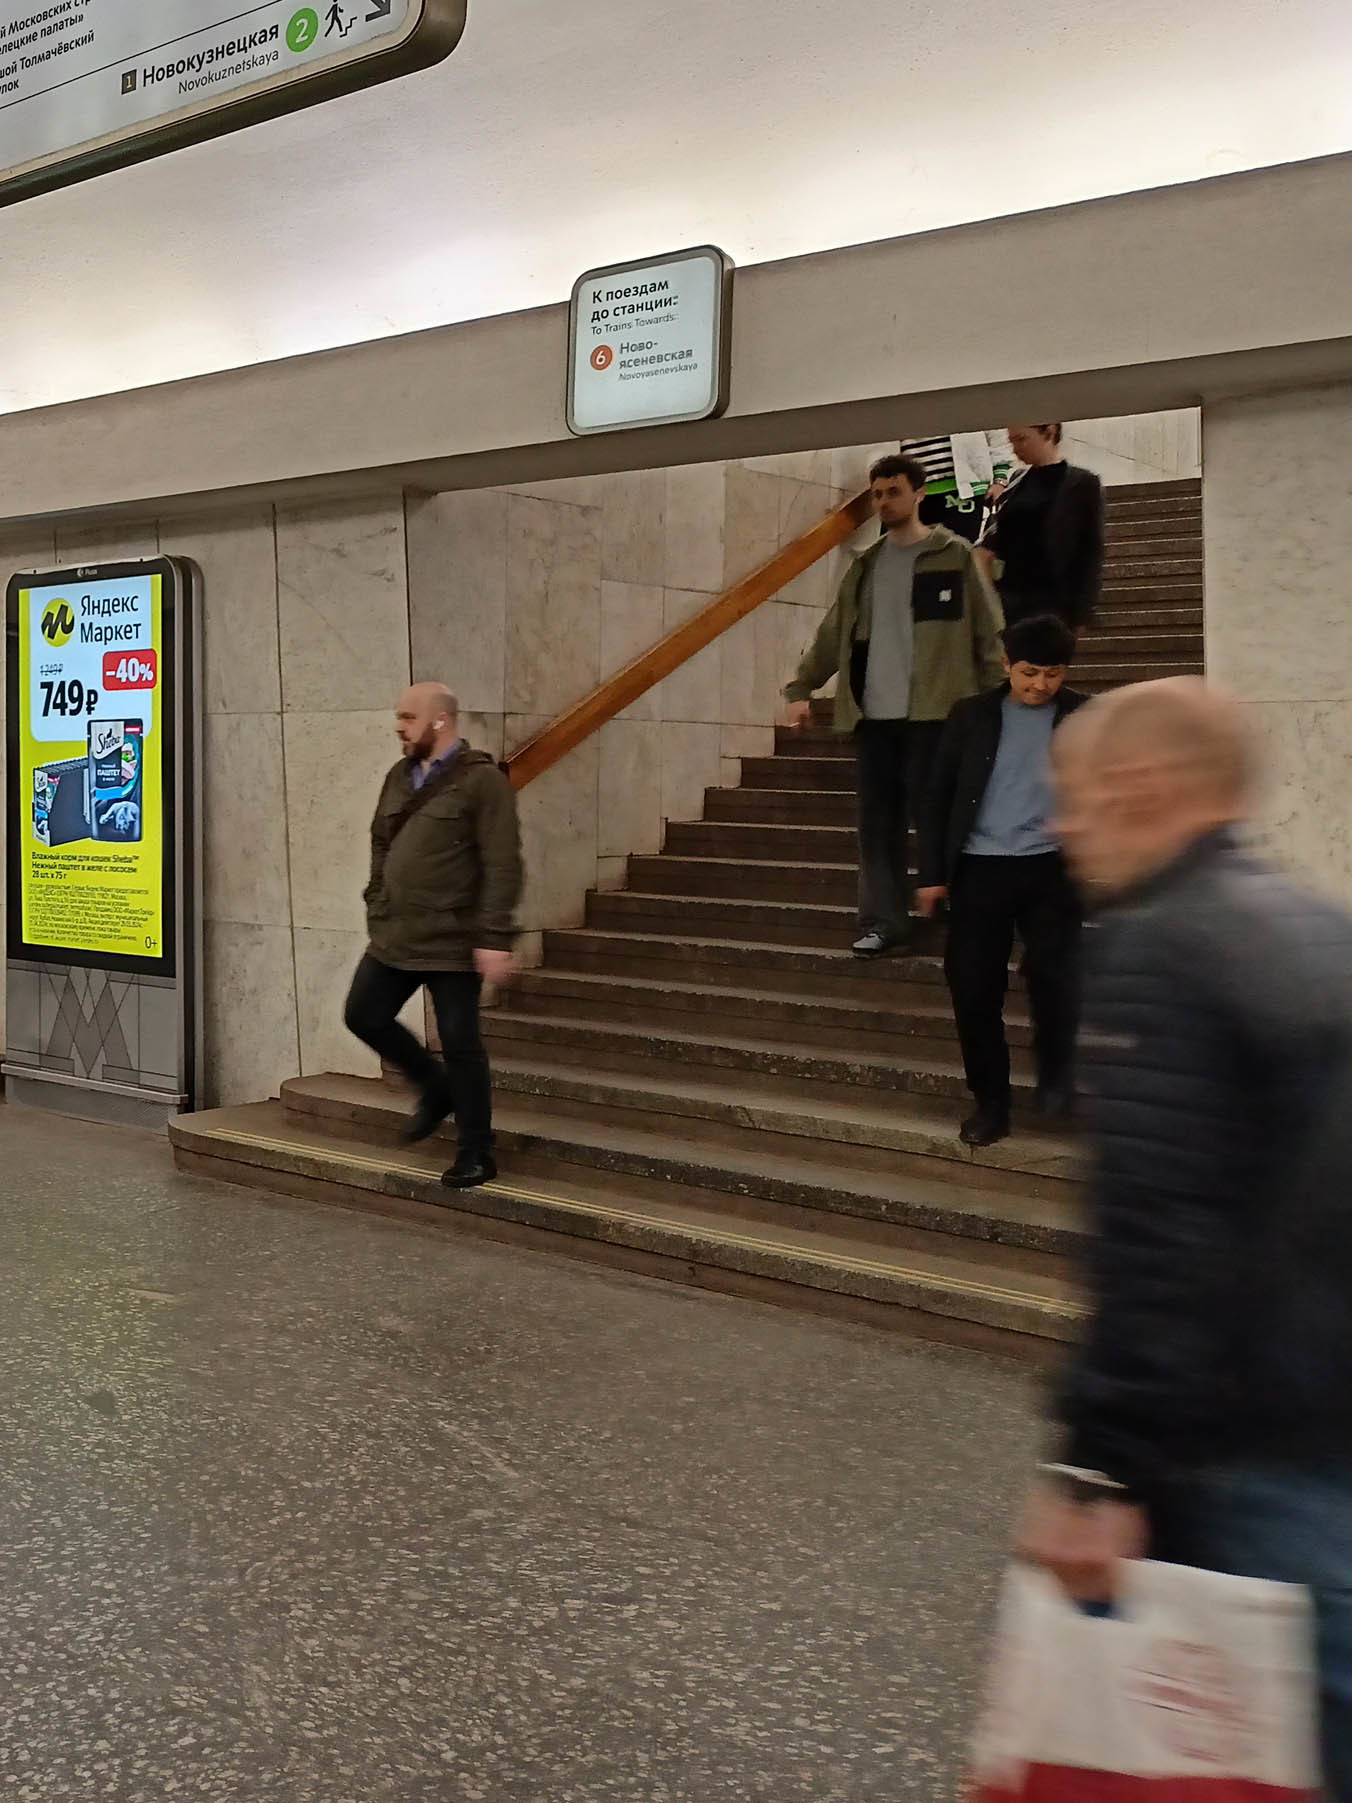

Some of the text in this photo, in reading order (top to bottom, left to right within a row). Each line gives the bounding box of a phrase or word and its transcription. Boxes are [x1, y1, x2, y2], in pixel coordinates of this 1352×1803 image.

[8, 1, 72, 36] Московских
[40, 14, 84, 39] палаты»
[19, 30, 95, 70] Толмачёвский
[143, 24, 279, 87] Новокузнецкая
[295, 18, 309, 43] 2
[178, 50, 279, 94] Novokuznetskaya
[592, 279, 669, 304] К поездам
[591, 295, 679, 323] до станции:
[591, 326, 602, 335] To
[605, 321, 632, 334] Trains
[595, 339, 658, 366] 6 Ново-
[619, 348, 693, 369] ясеневская
[618, 362, 698, 381] Novoyasenevskaya
[81, 594, 139, 617] Яндекс
[80, 622, 141, 645] Маркет
[96, 732, 121, 754] Sheba
[145, 936, 158, 949] 0+
